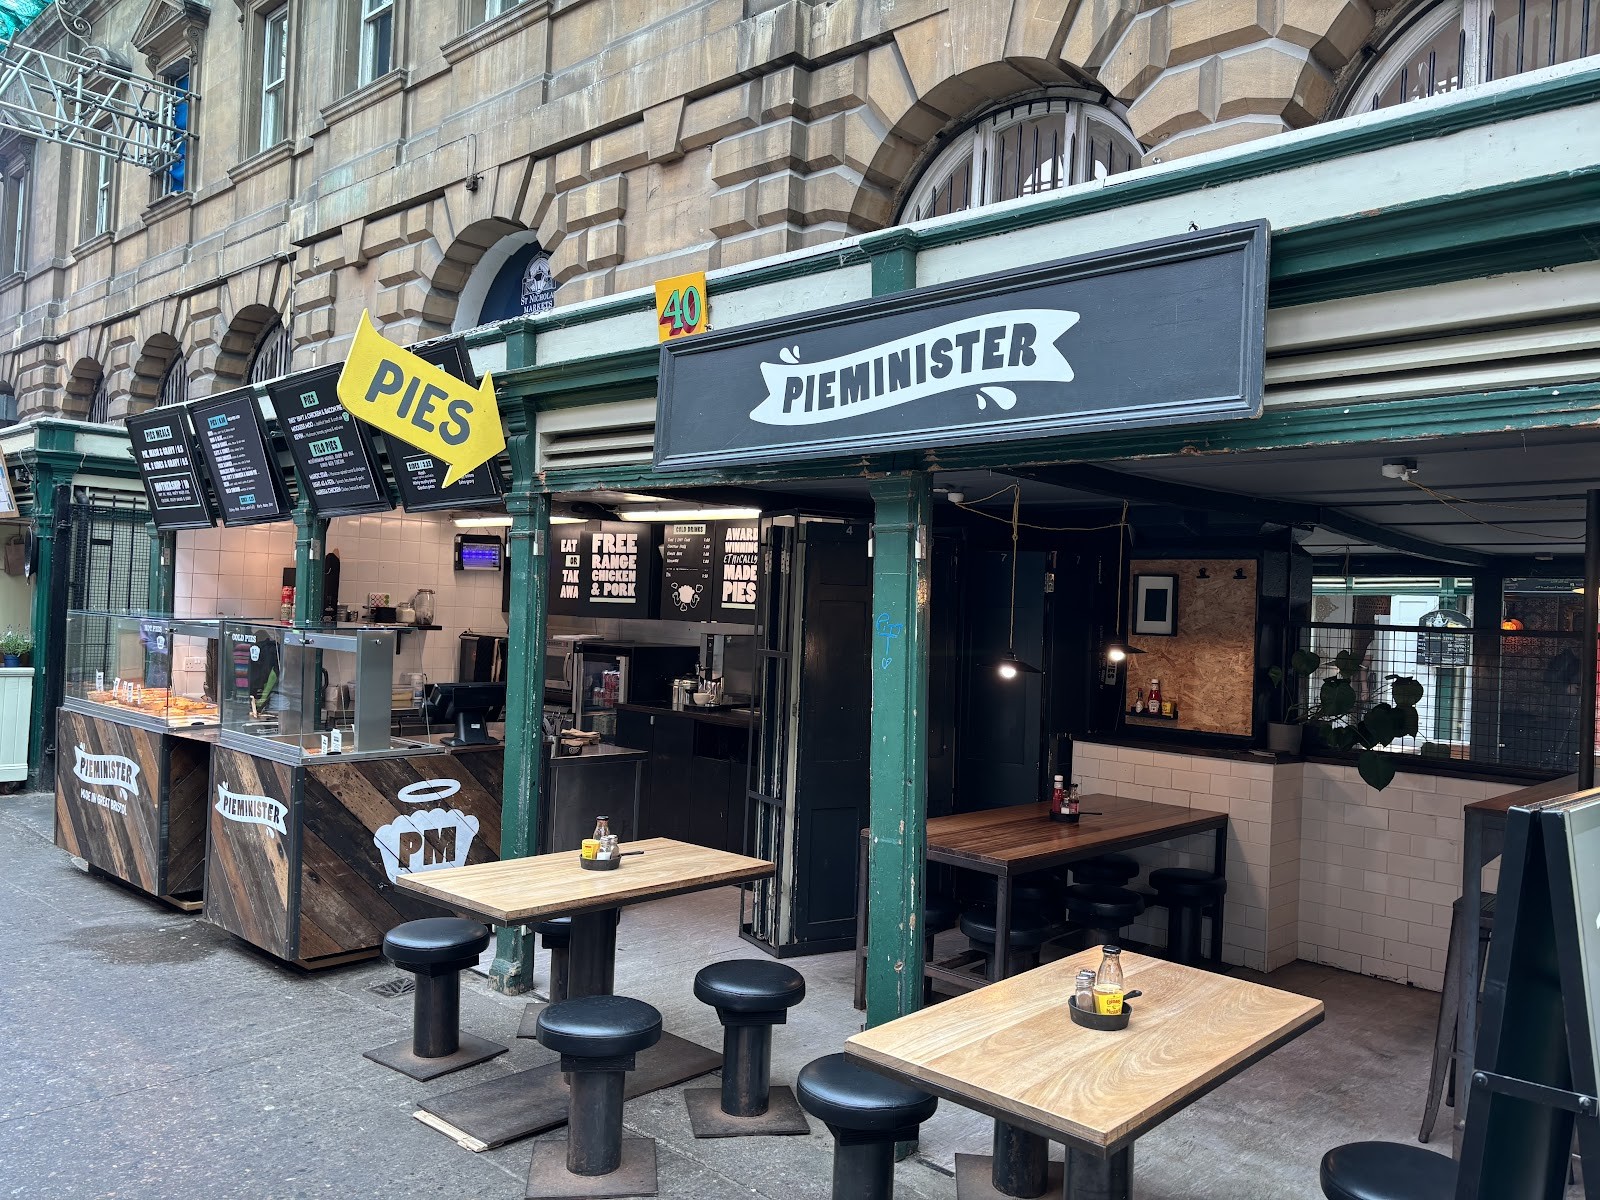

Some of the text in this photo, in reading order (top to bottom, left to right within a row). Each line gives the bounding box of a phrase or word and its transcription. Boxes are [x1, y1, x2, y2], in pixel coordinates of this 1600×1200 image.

[529, 291, 554, 303] NICHOLA
[523, 300, 553, 314] MARKETS
[662, 285, 702, 332] 40
[782, 322, 1038, 414] PIEMINISTER
[303, 394, 315, 406] PIES
[364, 358, 474, 446] PIES
[325, 439, 338, 452] PIES
[725, 527, 758, 541] AWARD
[846, 526, 853, 535] 4
[560, 539, 577, 553] EAT
[592, 533, 638, 554] FREE
[724, 541, 758, 553] WINNING
[569, 557, 577, 565] OR
[591, 554, 637, 569] RANGE
[723, 553, 758, 565] ETHICALLY
[562, 569, 580, 583] TAK
[591, 569, 636, 582] CHICKEN
[723, 564, 757, 581] MADE
[559, 584, 579, 599] AWA
[590, 582, 636, 597] & PORK
[722, 580, 757, 603] PIES
[231, 633, 257, 643] COLD PIES
[79, 756, 133, 785] PIEMINISTER
[96, 793, 111, 809] GREAT
[110, 798, 127, 816] BRISTOL
[222, 795, 280, 824] PIEMINISTER
[398, 826, 457, 869] PM
